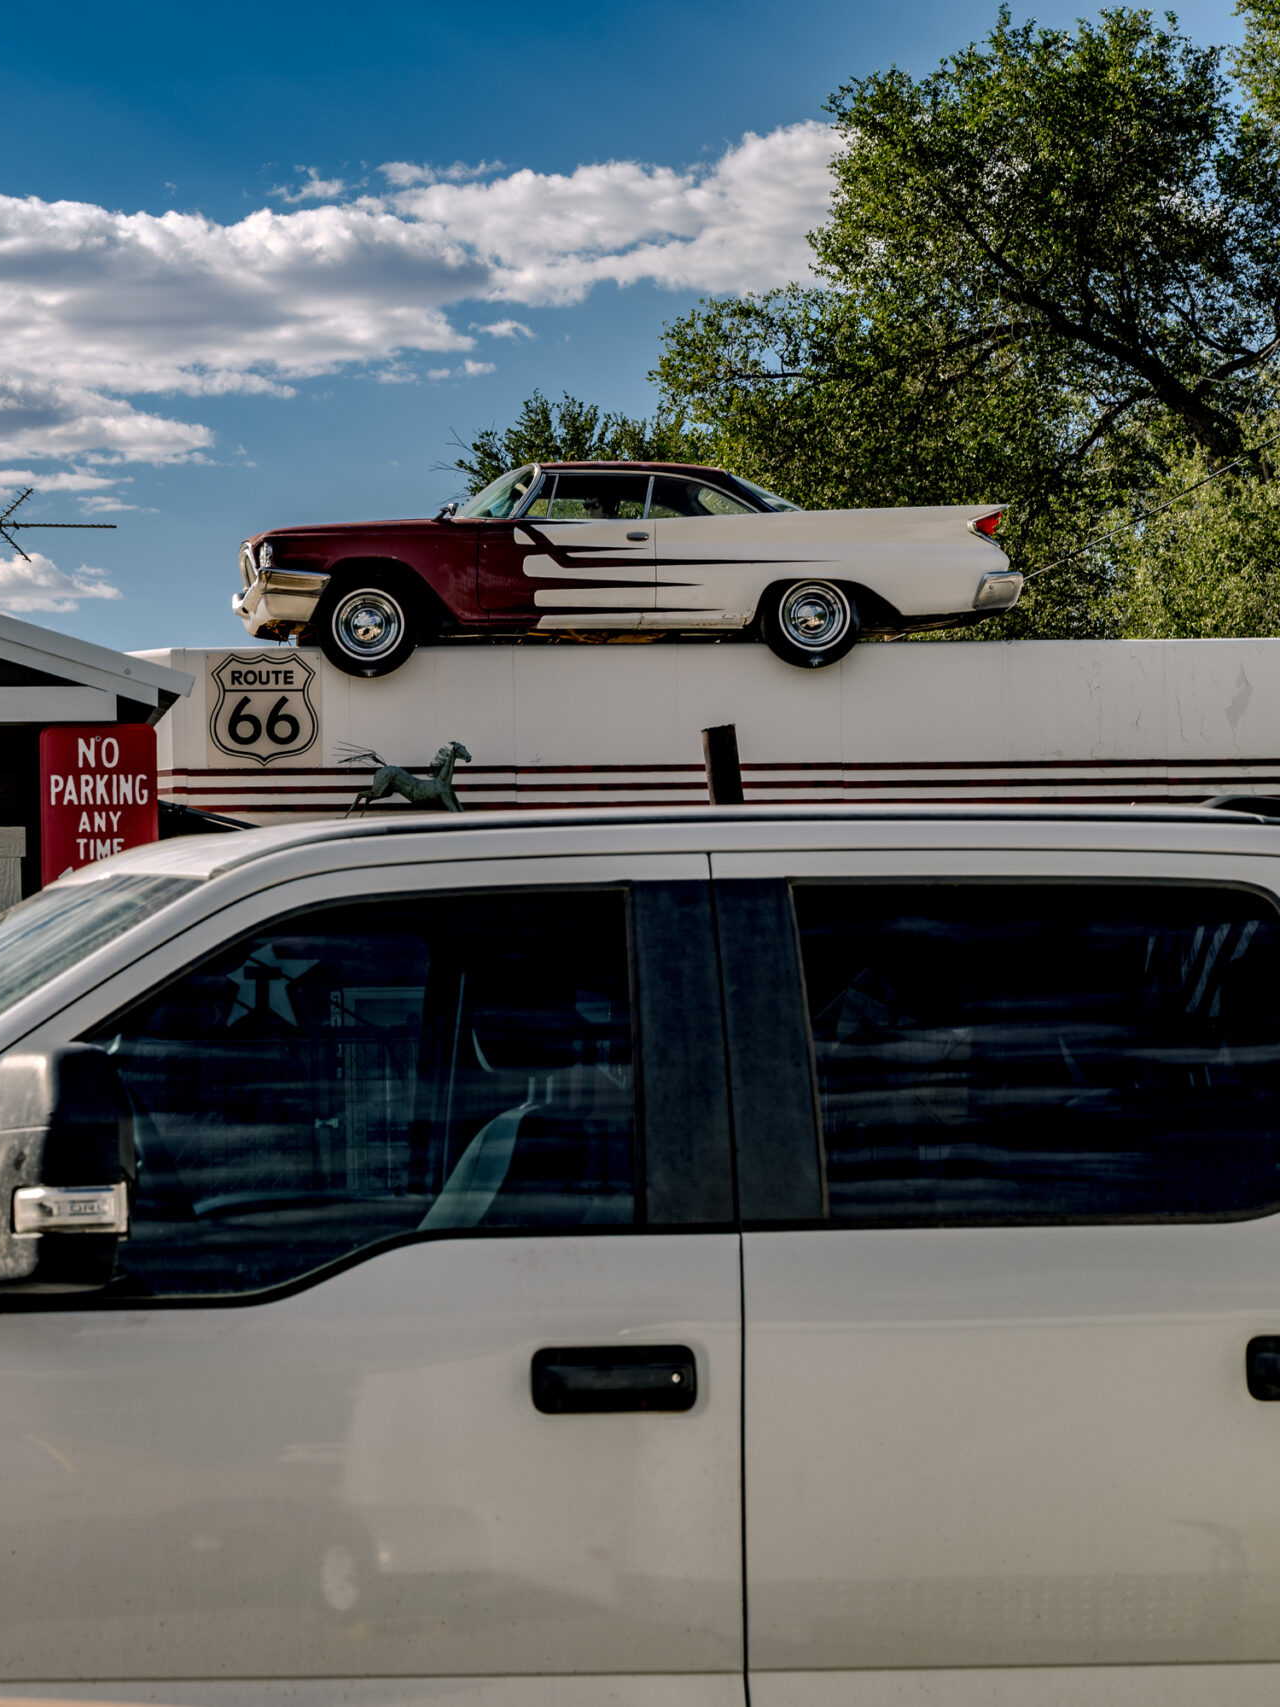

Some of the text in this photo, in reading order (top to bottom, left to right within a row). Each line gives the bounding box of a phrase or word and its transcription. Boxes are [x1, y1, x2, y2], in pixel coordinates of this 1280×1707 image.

[230, 670, 295, 685] ROUTE
[228, 695, 300, 745] 66
[77, 736, 120, 768] NO
[50, 774, 149, 806] PARKING
[78, 811, 122, 833] ANY
[76, 838, 125, 861] TIME
